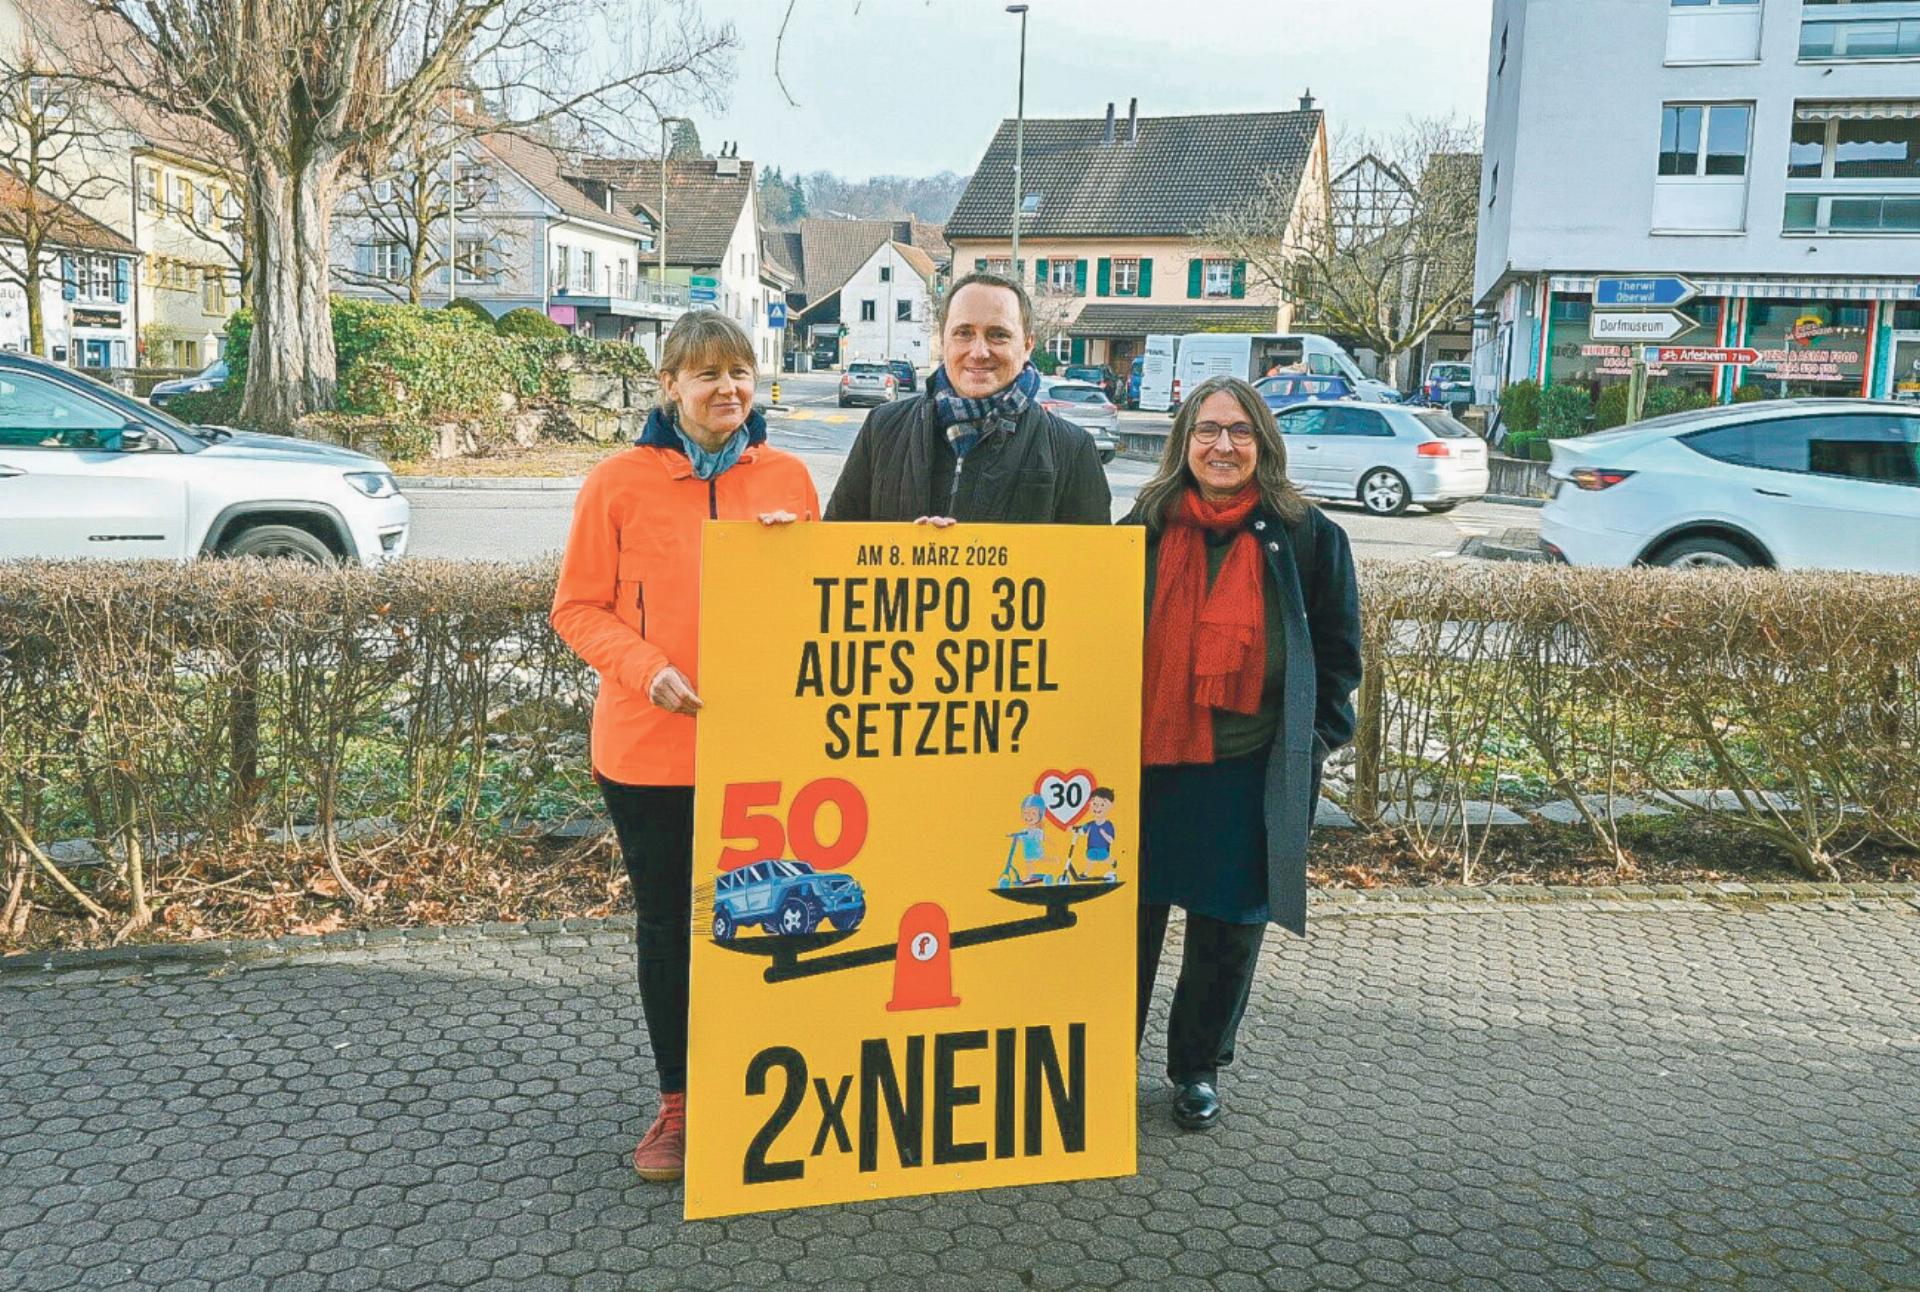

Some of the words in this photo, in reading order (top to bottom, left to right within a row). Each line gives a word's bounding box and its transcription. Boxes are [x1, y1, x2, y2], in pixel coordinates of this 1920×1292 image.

[1616, 292, 1655, 302] Oberwil
[1618, 280, 1655, 291] Therwil
[1600, 319, 1664, 332] Dorfmuseum
[1680, 350, 1728, 361] Arlesheim
[1738, 352, 1751, 361] km
[1830, 351, 1858, 363] FOOD
[857, 545, 883, 565] AM
[890, 545, 905, 565] 8.
[912, 542, 959, 566] MÄRZ
[966, 546, 1008, 566] 2026
[813, 576, 971, 633] TEMPO
[990, 576, 1047, 632] 30
[795, 640, 915, 697] AUFS
[934, 638, 1058, 694] SPIEL
[824, 698, 1029, 760] SETZEN?
[1049, 782, 1082, 809] 30
[717, 777, 869, 872] 50
